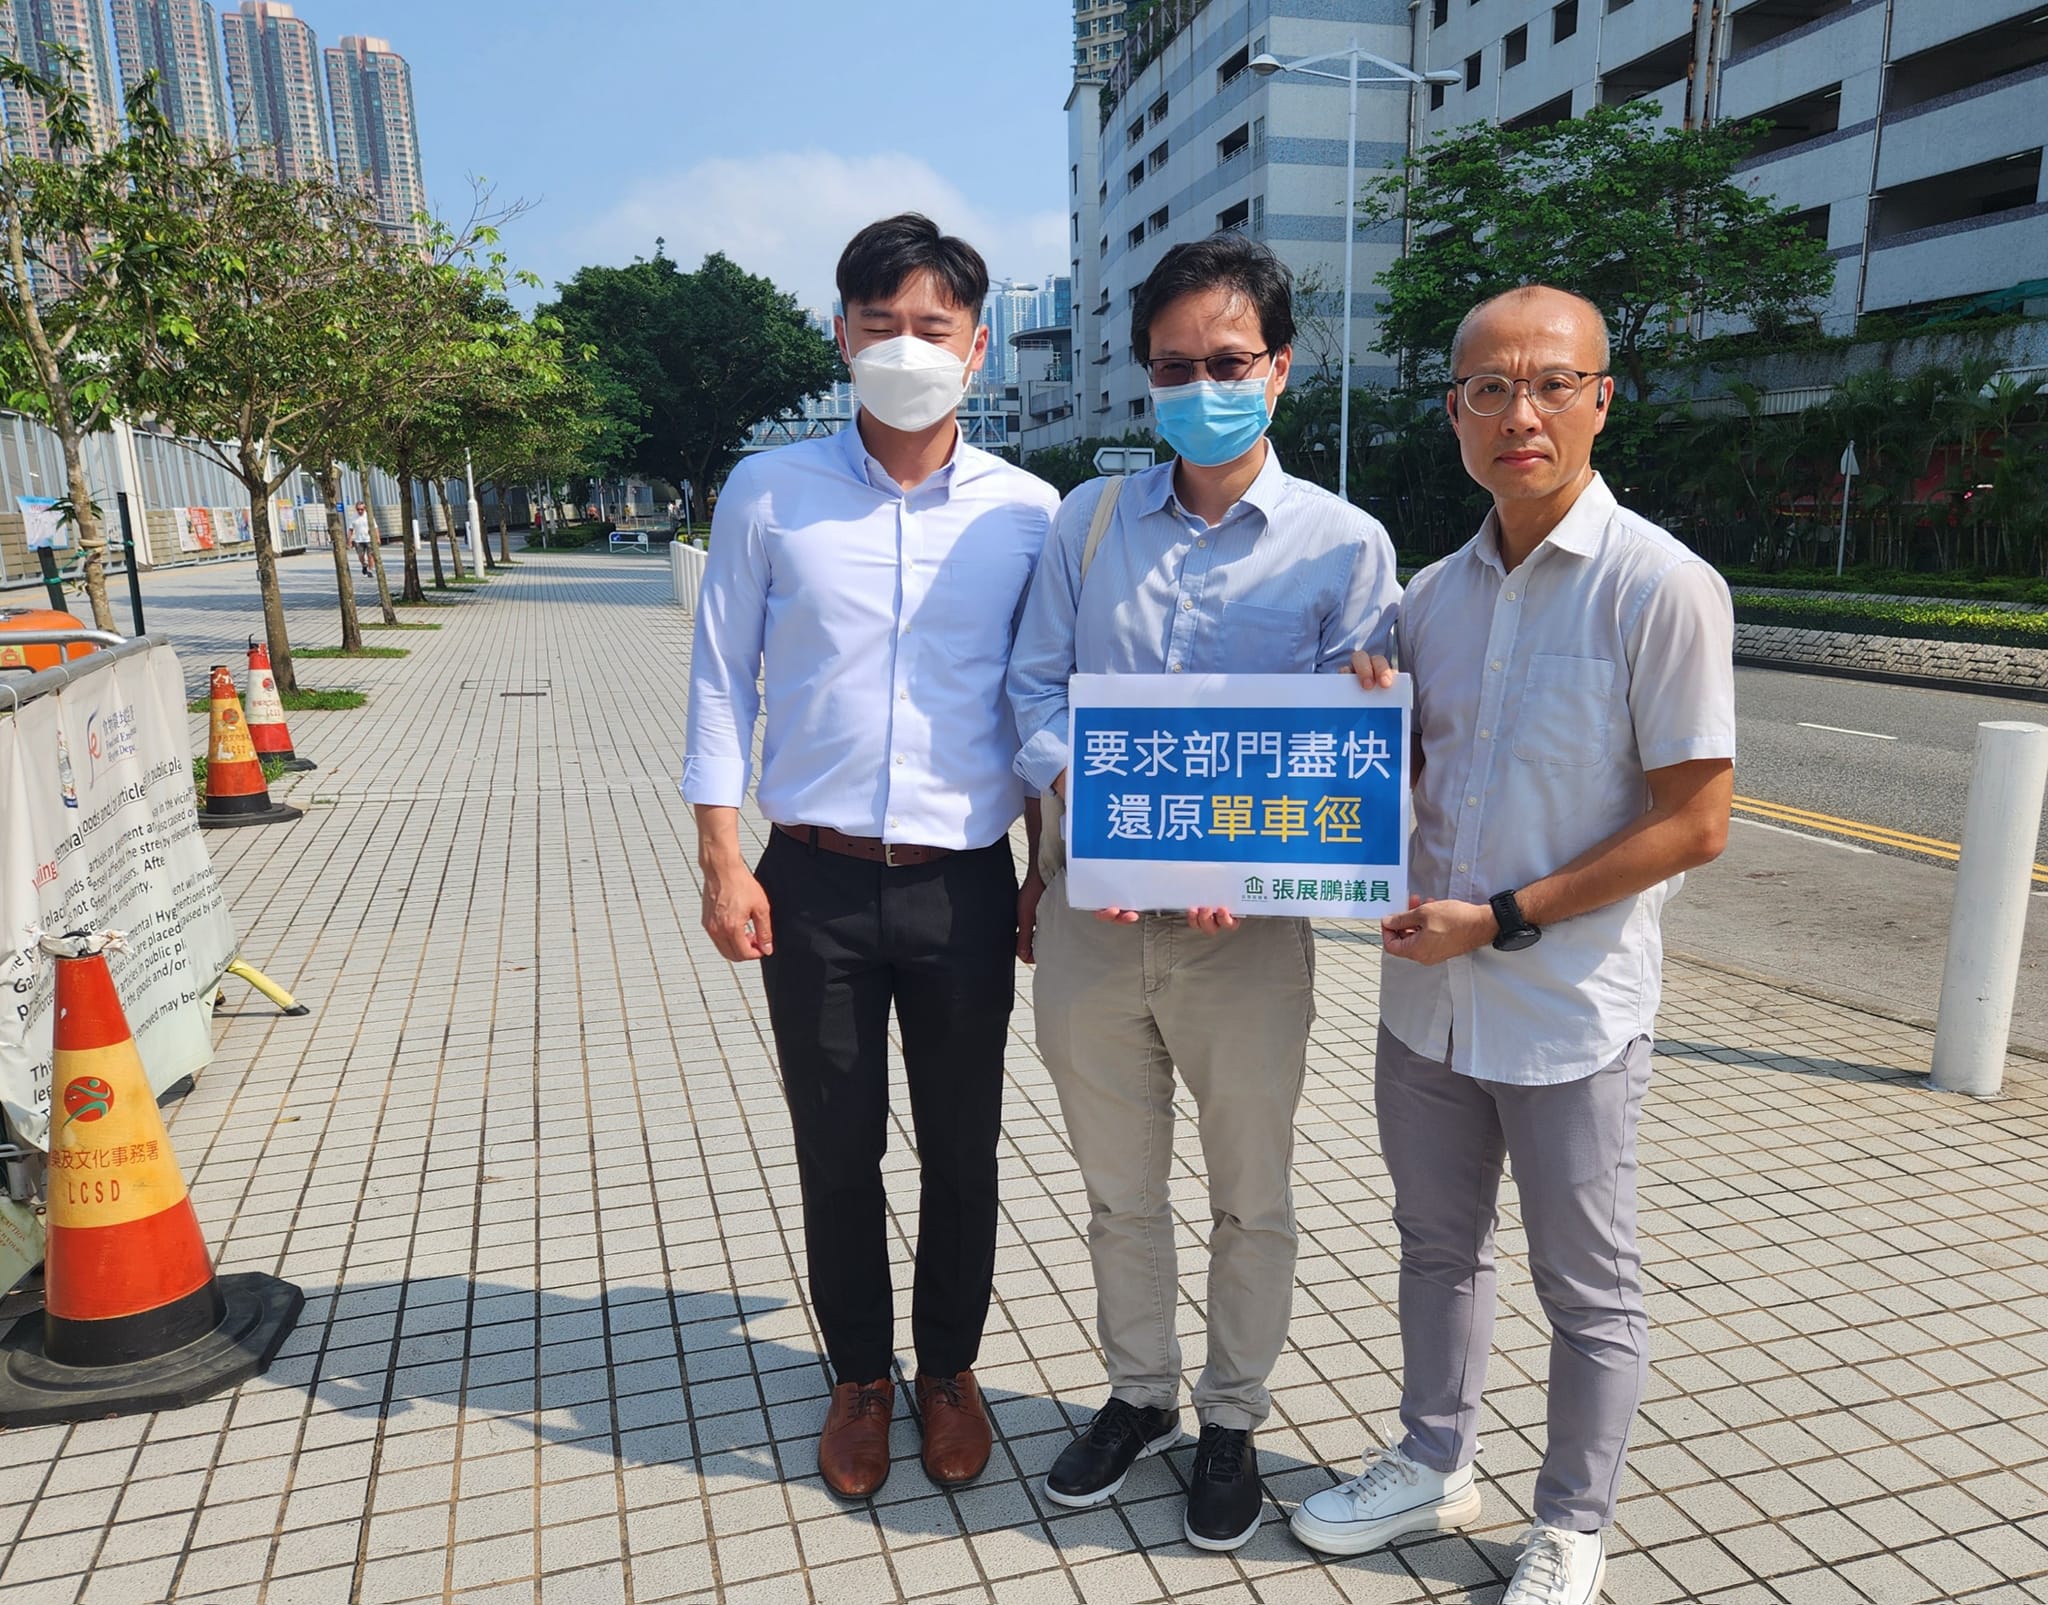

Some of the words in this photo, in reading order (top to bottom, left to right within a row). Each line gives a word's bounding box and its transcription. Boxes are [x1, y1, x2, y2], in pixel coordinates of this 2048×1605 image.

[1084, 730, 1391, 780] 要求部門盡快
[1107, 793, 1363, 843] 還原單車徑
[1272, 879, 1391, 902] 張展鵬議員
[68, 1180, 120, 1205] LCSD
